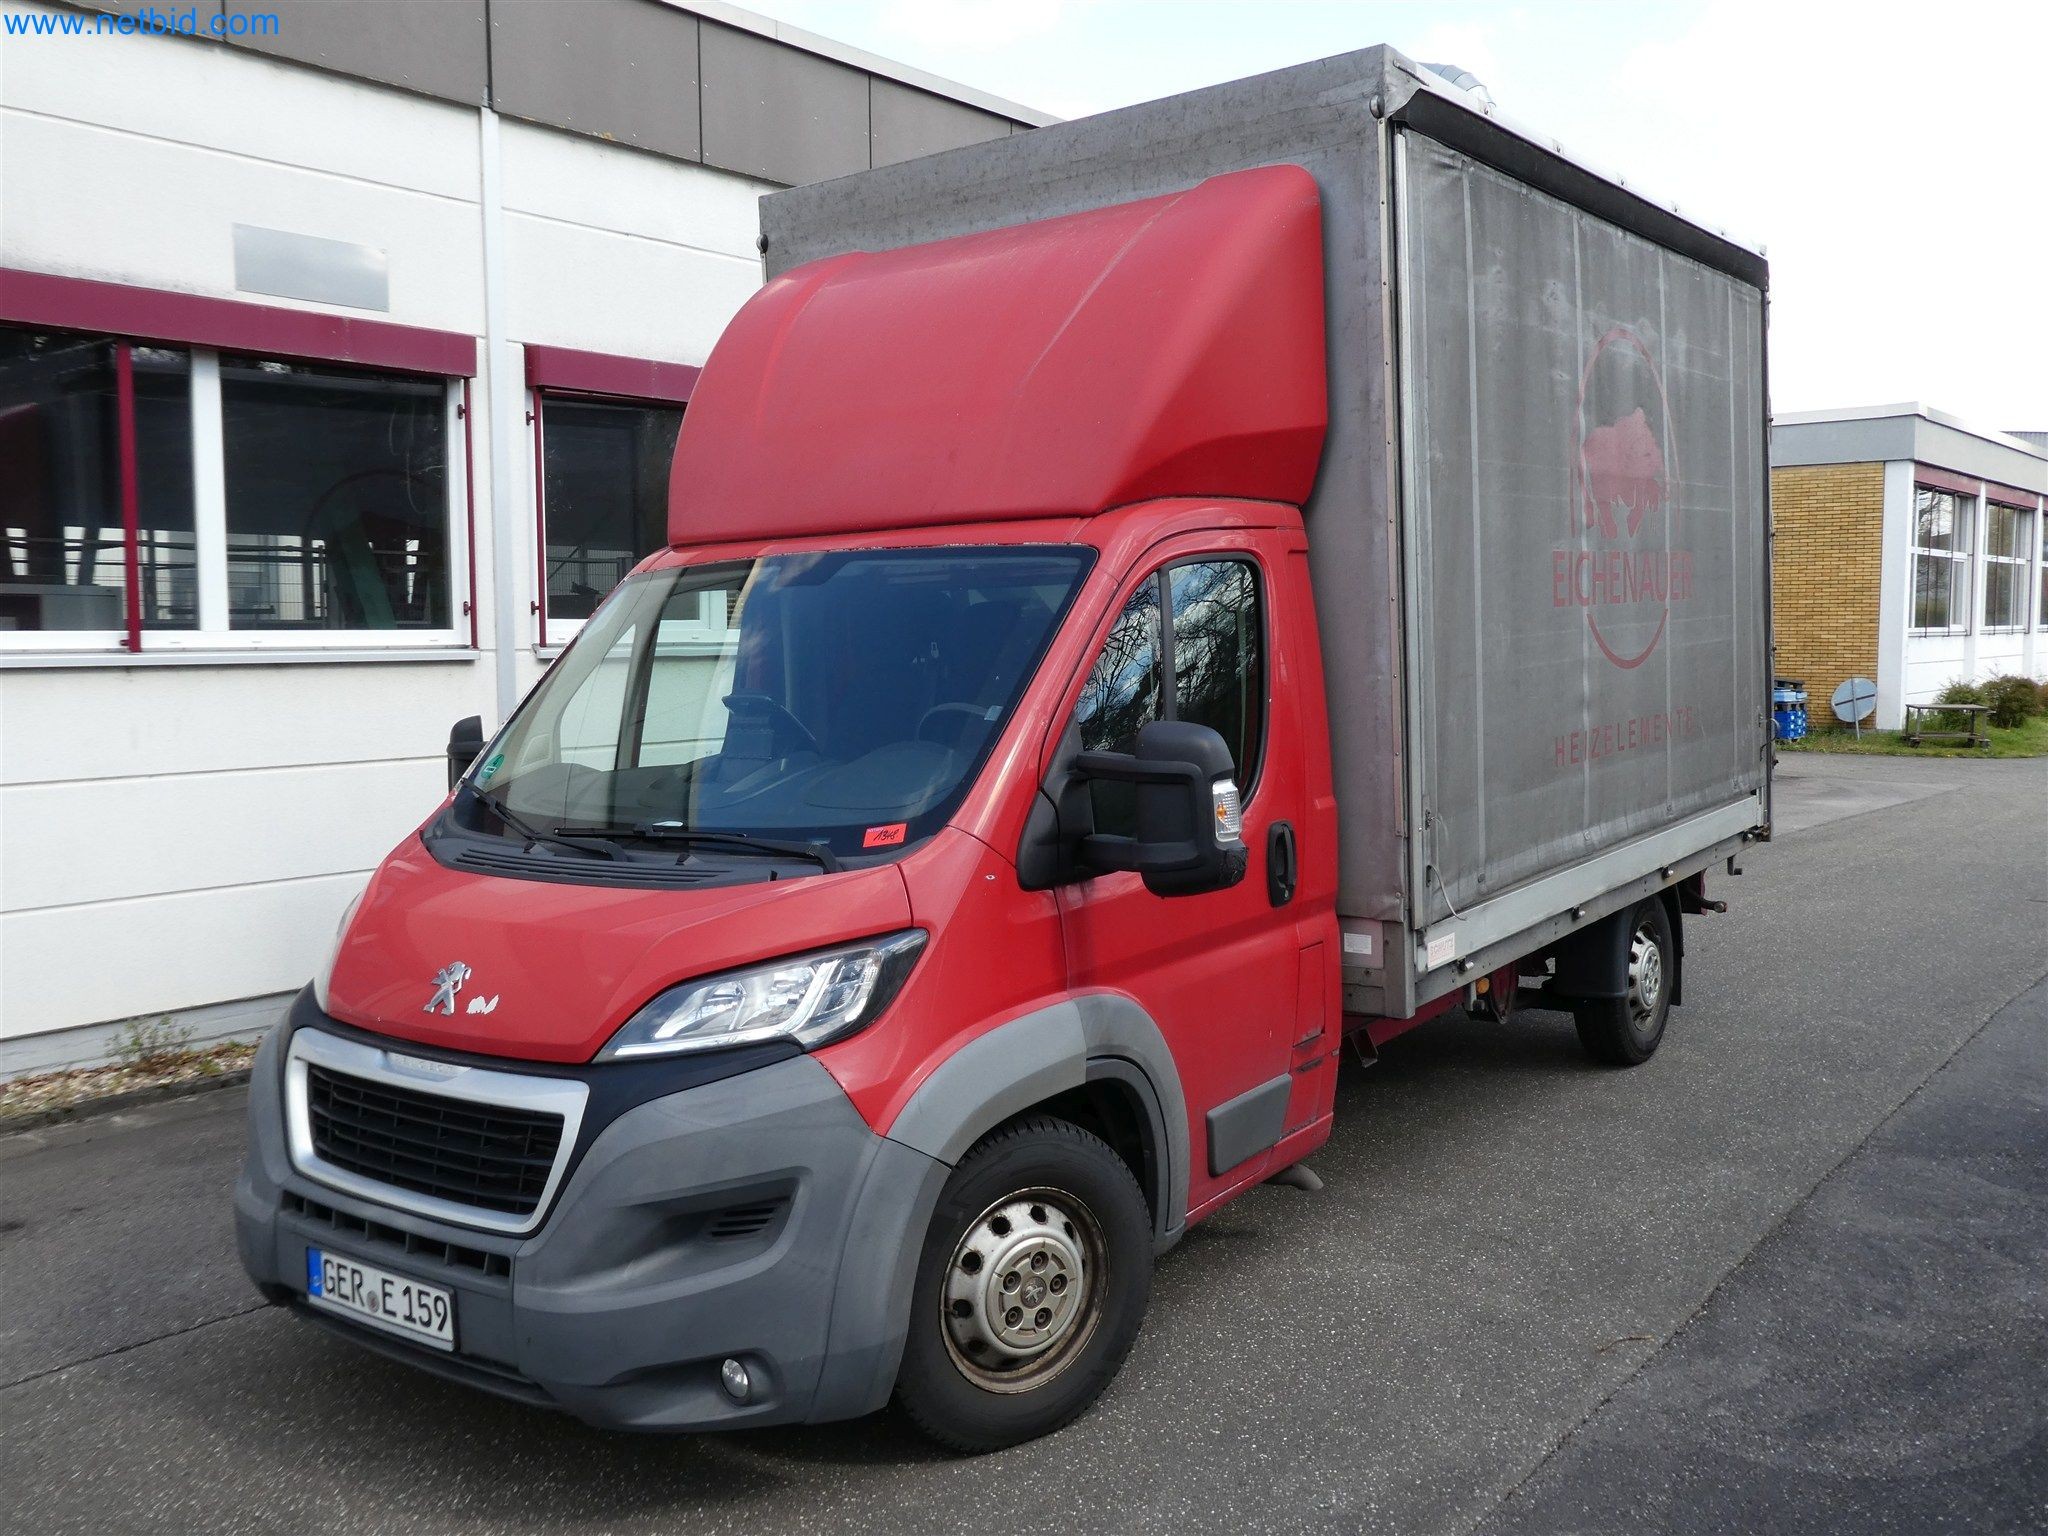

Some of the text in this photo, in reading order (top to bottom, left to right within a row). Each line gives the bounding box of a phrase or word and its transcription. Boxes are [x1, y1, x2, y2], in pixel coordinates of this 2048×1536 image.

[1552, 550, 1693, 608] EICHENAUER
[1553, 706, 1696, 768] HEIZELEMENTE
[323, 1258, 366, 1307] GER
